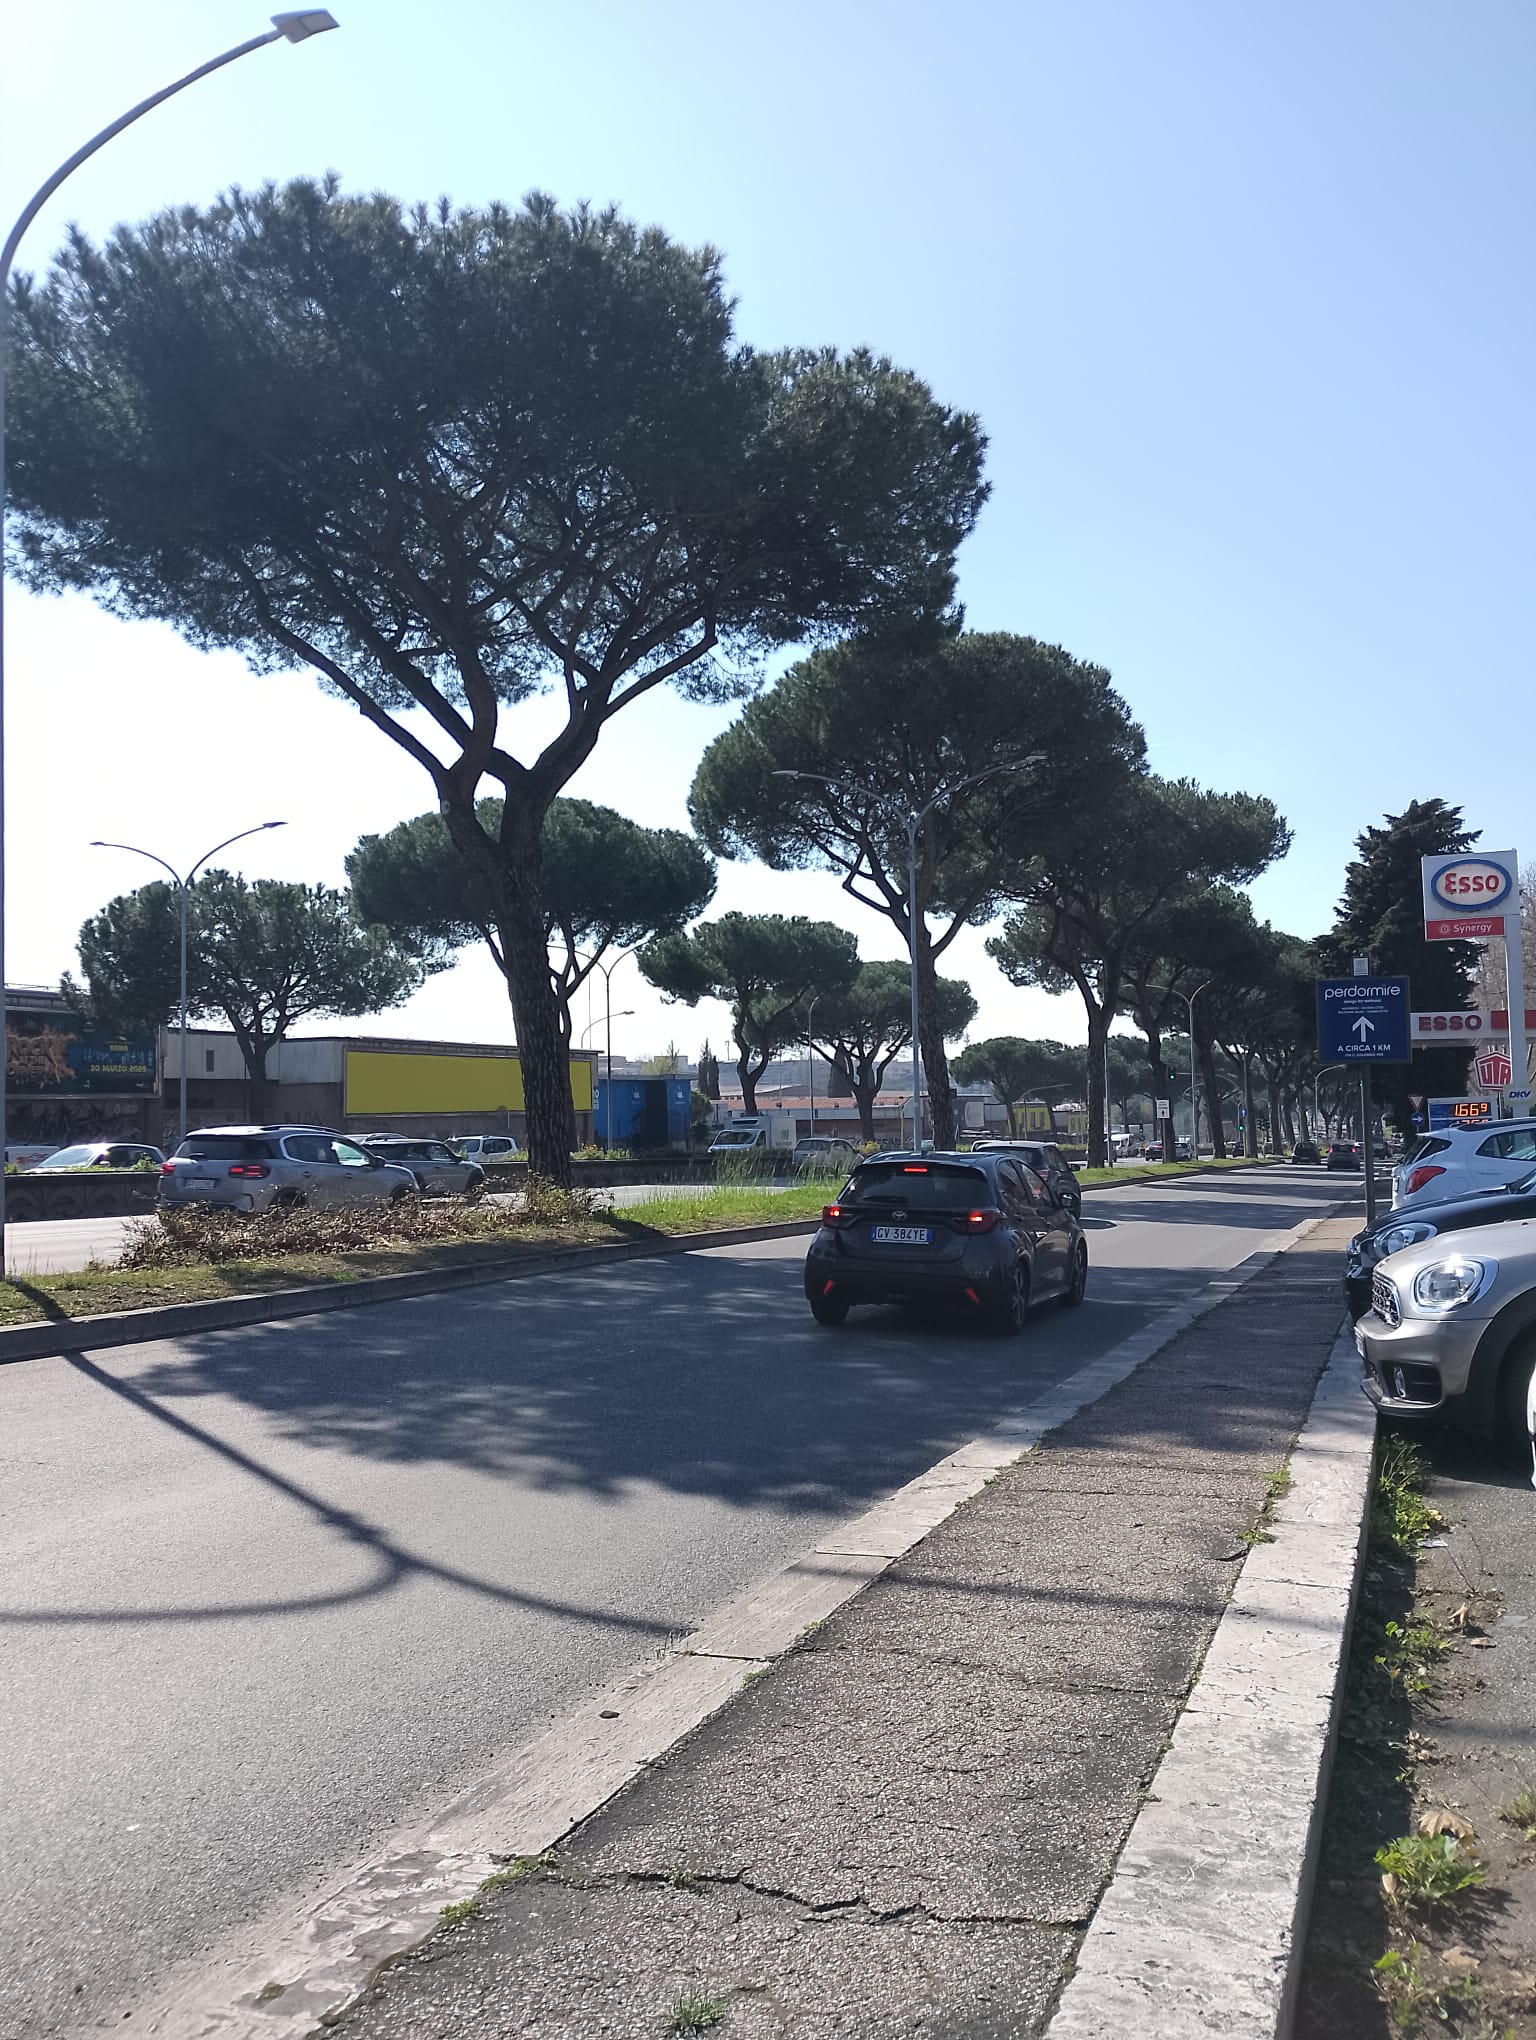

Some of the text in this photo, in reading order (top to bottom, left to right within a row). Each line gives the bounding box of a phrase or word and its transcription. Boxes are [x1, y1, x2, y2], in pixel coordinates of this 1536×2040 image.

[1453, 923, 1492, 934] Synergy
[1324, 985, 1401, 1000] perdormire
[1418, 1015, 1482, 1031] ESSO
[1378, 1044, 1391, 1052] KM
[102, 1065, 127, 1073] MARZO
[1508, 1090, 1531, 1099] DKV
